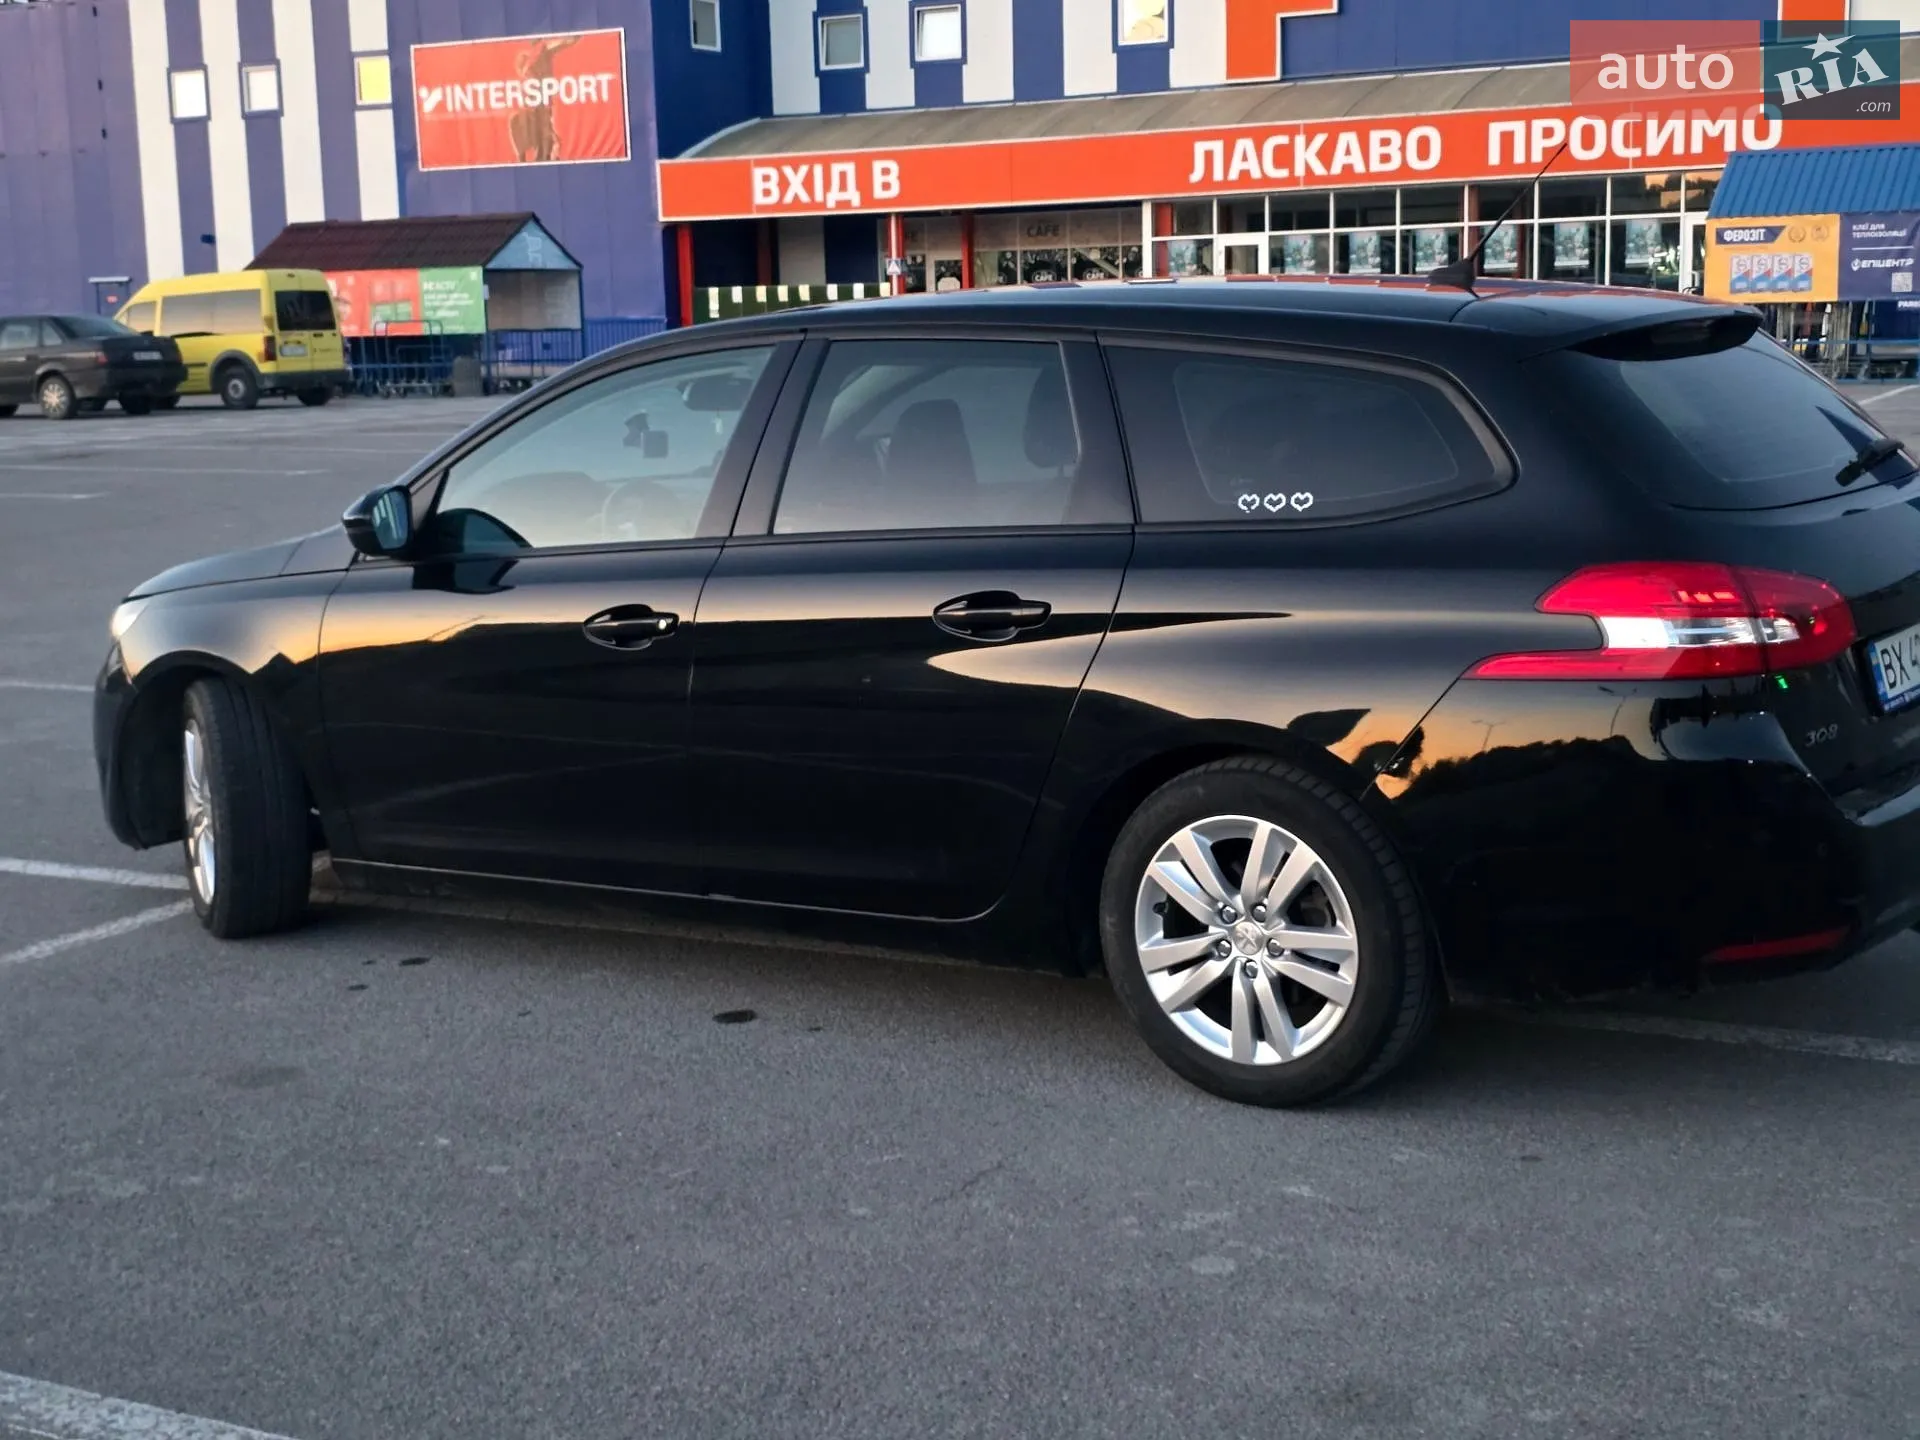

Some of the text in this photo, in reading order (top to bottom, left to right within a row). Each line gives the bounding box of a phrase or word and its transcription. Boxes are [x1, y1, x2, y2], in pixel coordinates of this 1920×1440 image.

[446, 73, 615, 112] INTERSPORT
[1189, 104, 1783, 184] ЛАСКАВО ПРОСИМО
[753, 159, 901, 209] ВХІД В
[1723, 228, 1766, 243] ФЕРОЗІТ
[1805, 723, 1838, 748] 308
